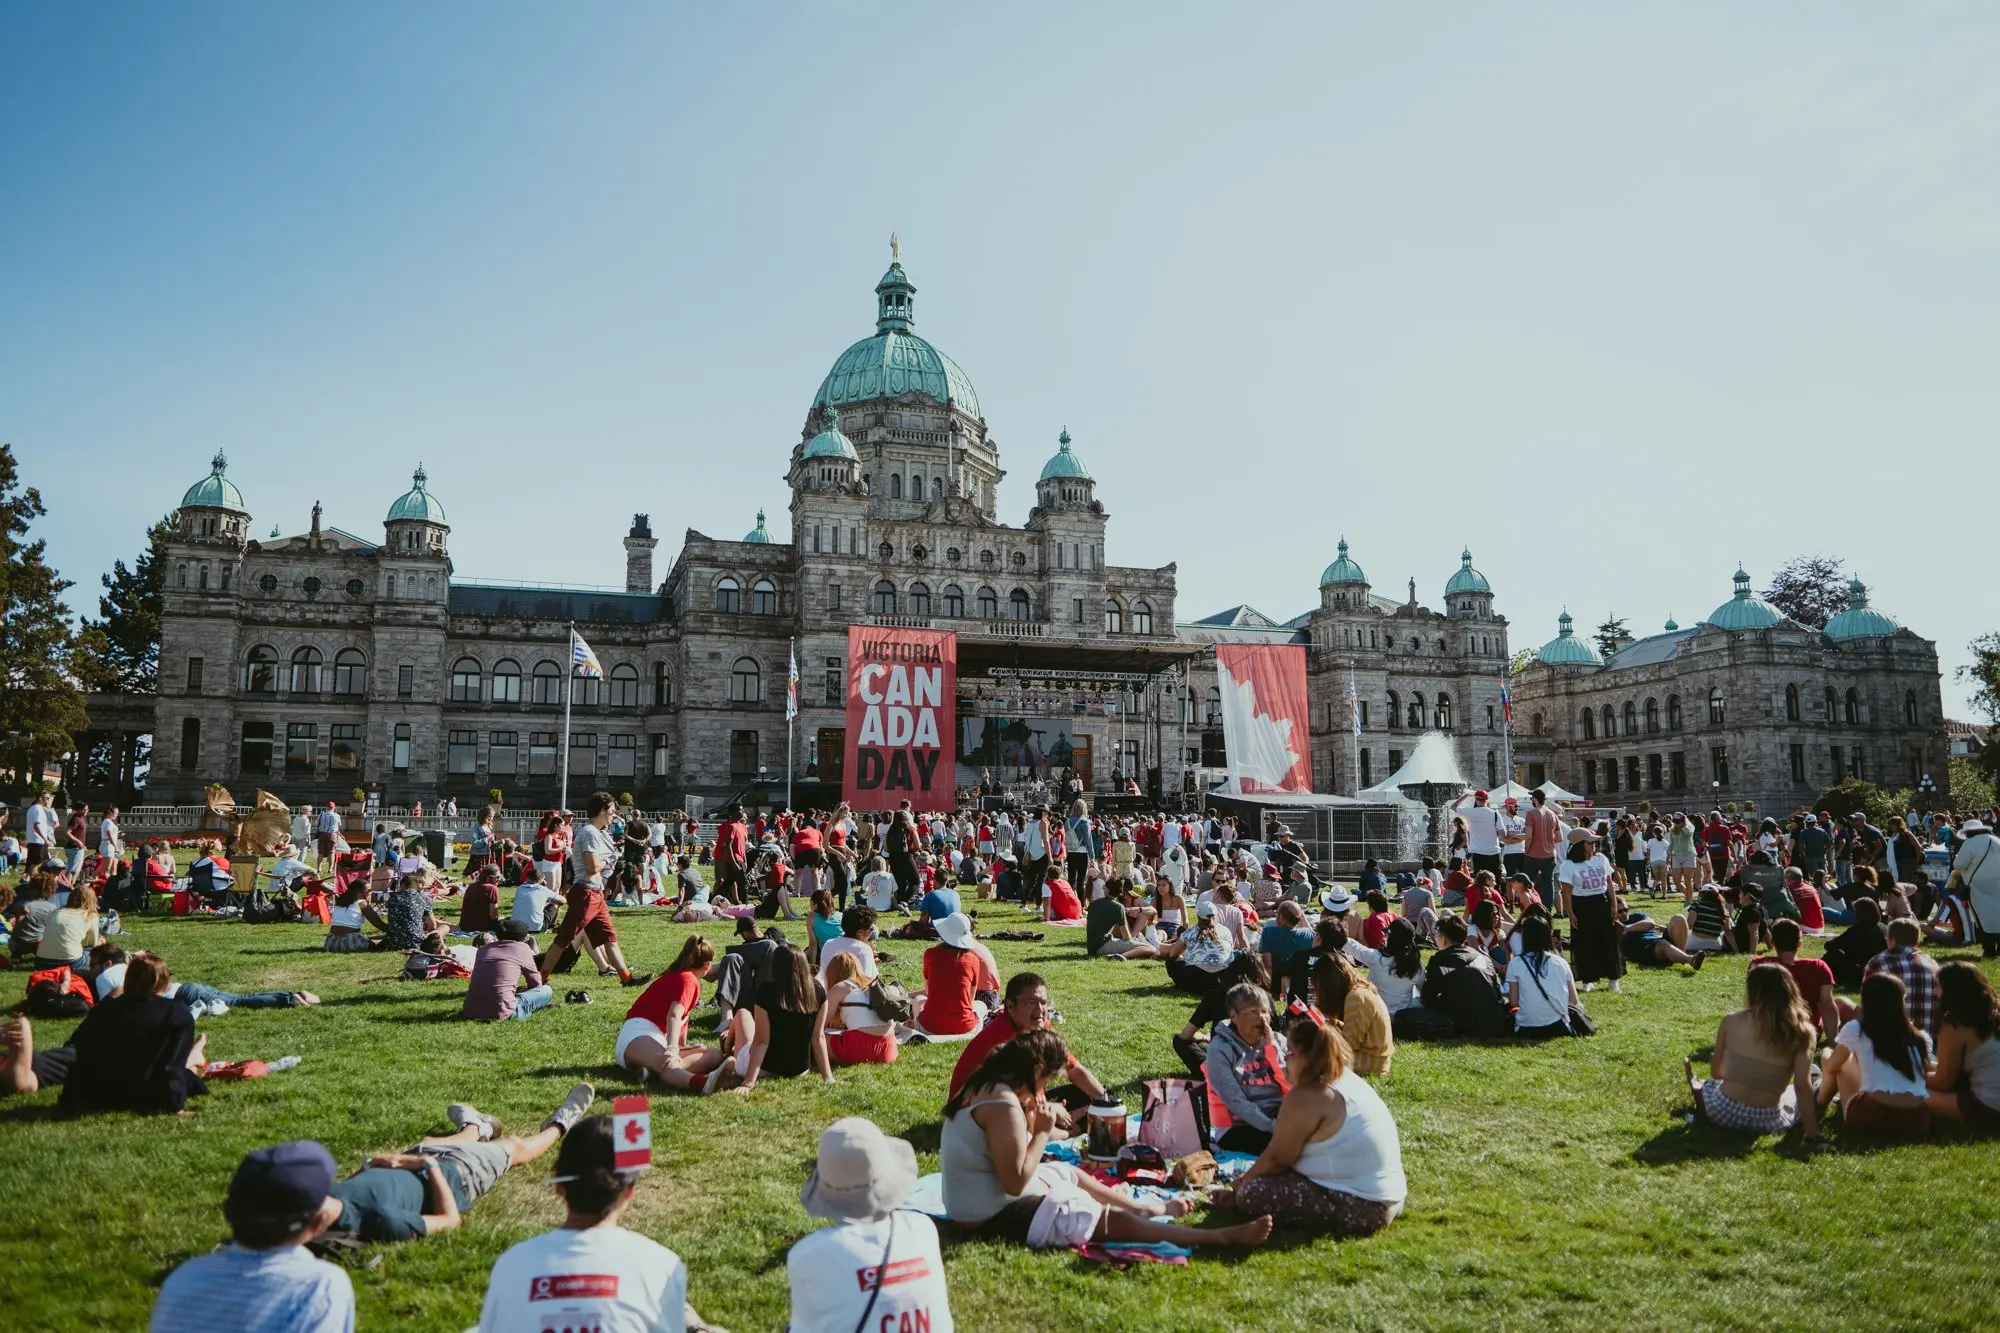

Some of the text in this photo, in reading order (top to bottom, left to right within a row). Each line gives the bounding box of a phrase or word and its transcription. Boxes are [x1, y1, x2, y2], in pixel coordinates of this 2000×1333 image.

[862, 640, 943, 664] VICTORIA
[859, 663, 942, 707] CAN
[857, 705, 941, 748] ADA
[856, 747, 941, 792] DAY
[1579, 867, 1605, 880] CAN
